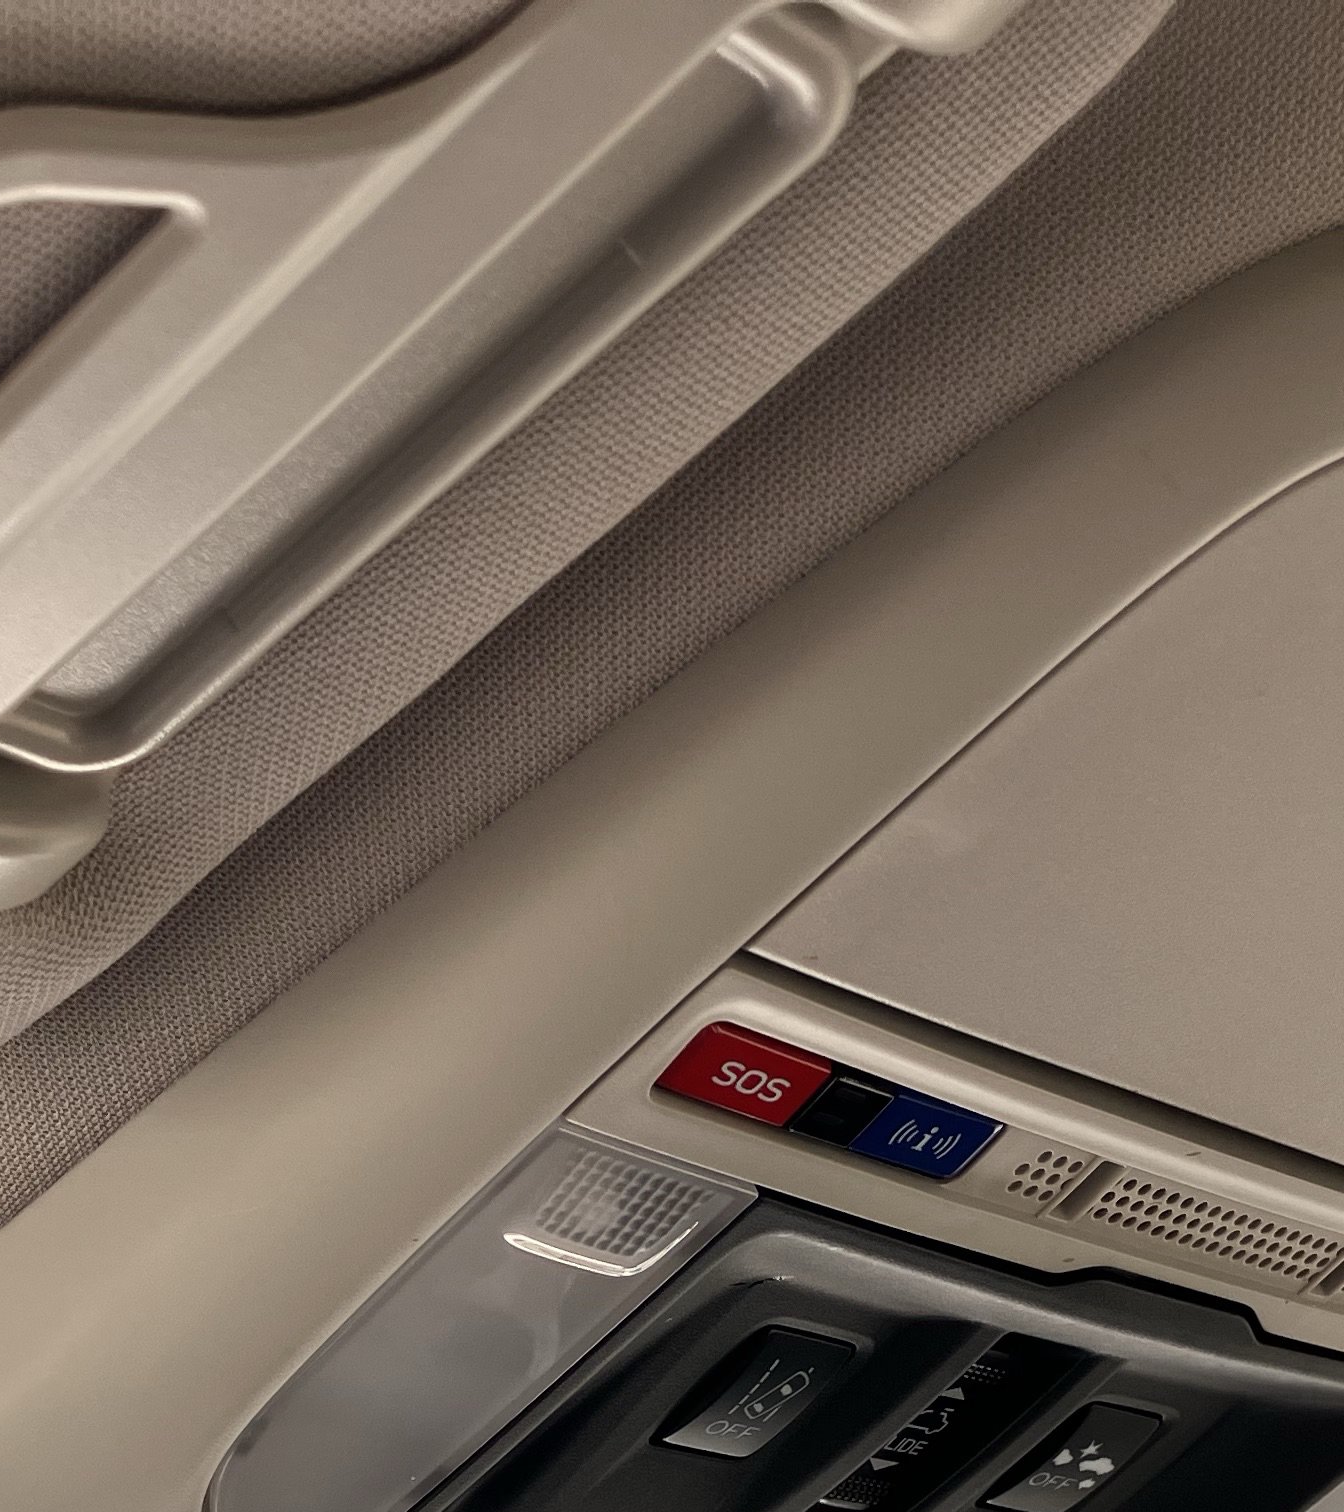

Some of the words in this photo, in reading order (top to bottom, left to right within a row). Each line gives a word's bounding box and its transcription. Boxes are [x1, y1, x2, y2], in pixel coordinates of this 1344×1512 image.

[710, 1060, 791, 1103] SOS
[704, 1419, 761, 1442] OFF
[883, 1436, 929, 1456] LIDE
[1027, 1471, 1075, 1491] OFF
